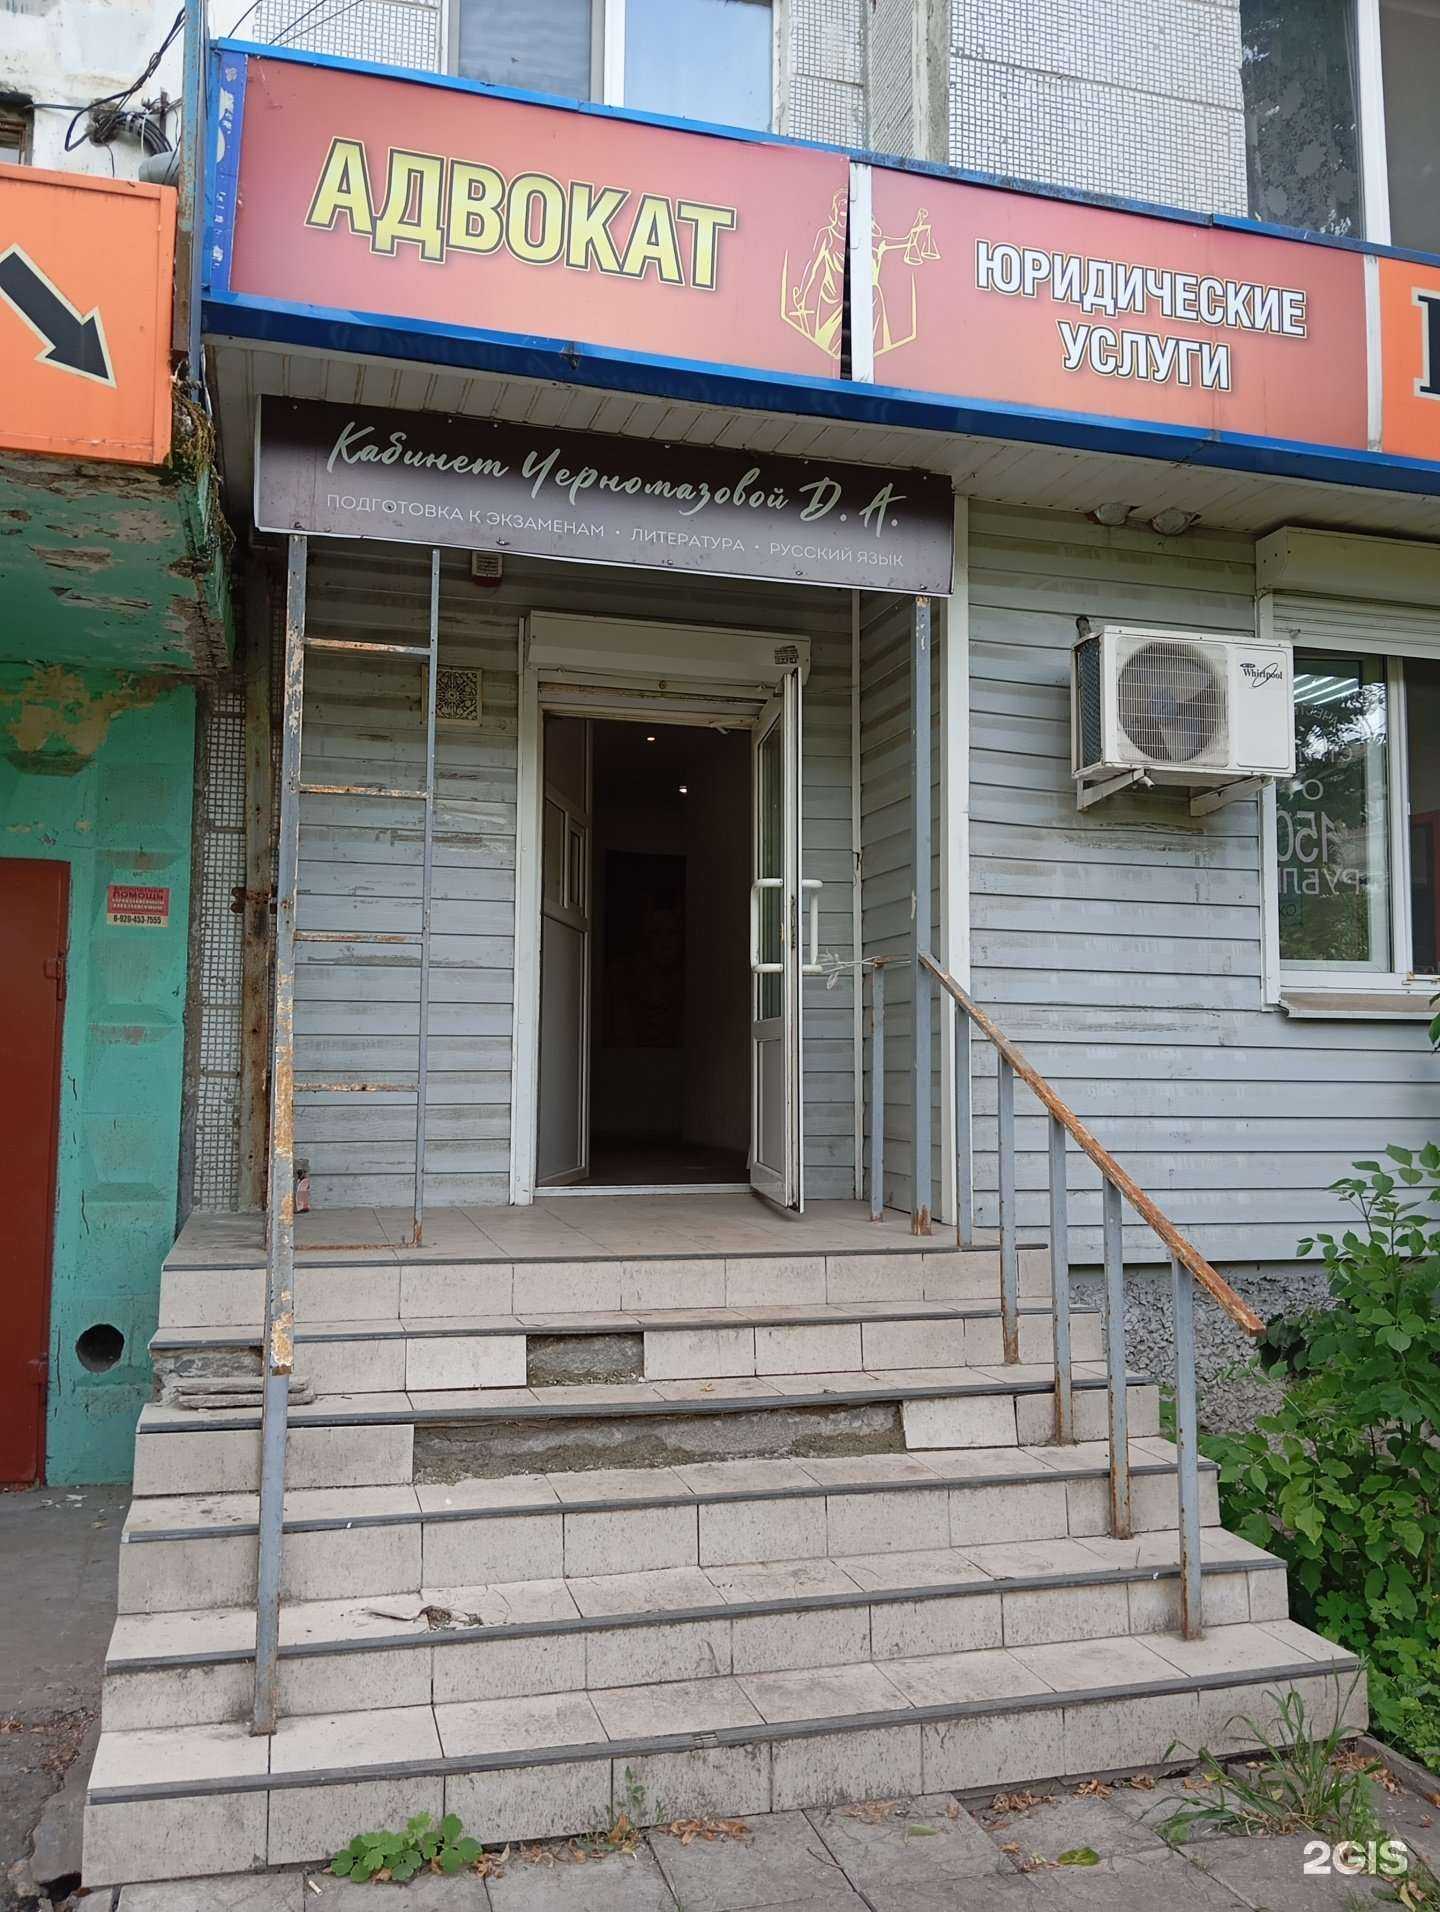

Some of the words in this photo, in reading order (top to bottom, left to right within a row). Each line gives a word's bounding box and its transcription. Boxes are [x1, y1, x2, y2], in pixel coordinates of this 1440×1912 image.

[305, 136, 738, 292] АДВОКАТ
[975, 238, 1308, 339] ЮРИДИЧЕСКИЕ
[1056, 319, 1233, 392] УСЛУГИ
[326, 421, 511, 477] Кабинет
[522, 448, 789, 516] Черномазовой
[799, 476, 848, 522] Д.
[858, 482, 908, 538] А.
[326, 493, 464, 521] ПОДГОТОВКА
[469, 509, 482, 524] К
[486, 510, 605, 538] ЭКЗАМЕНАМ
[631, 527, 745, 552] ЛИТЕРАТУРА
[769, 541, 853, 562] РУССКИЙ
[856, 550, 904, 568] ЯЗЫК
[1243, 667, 1283, 682] Whirlpool
